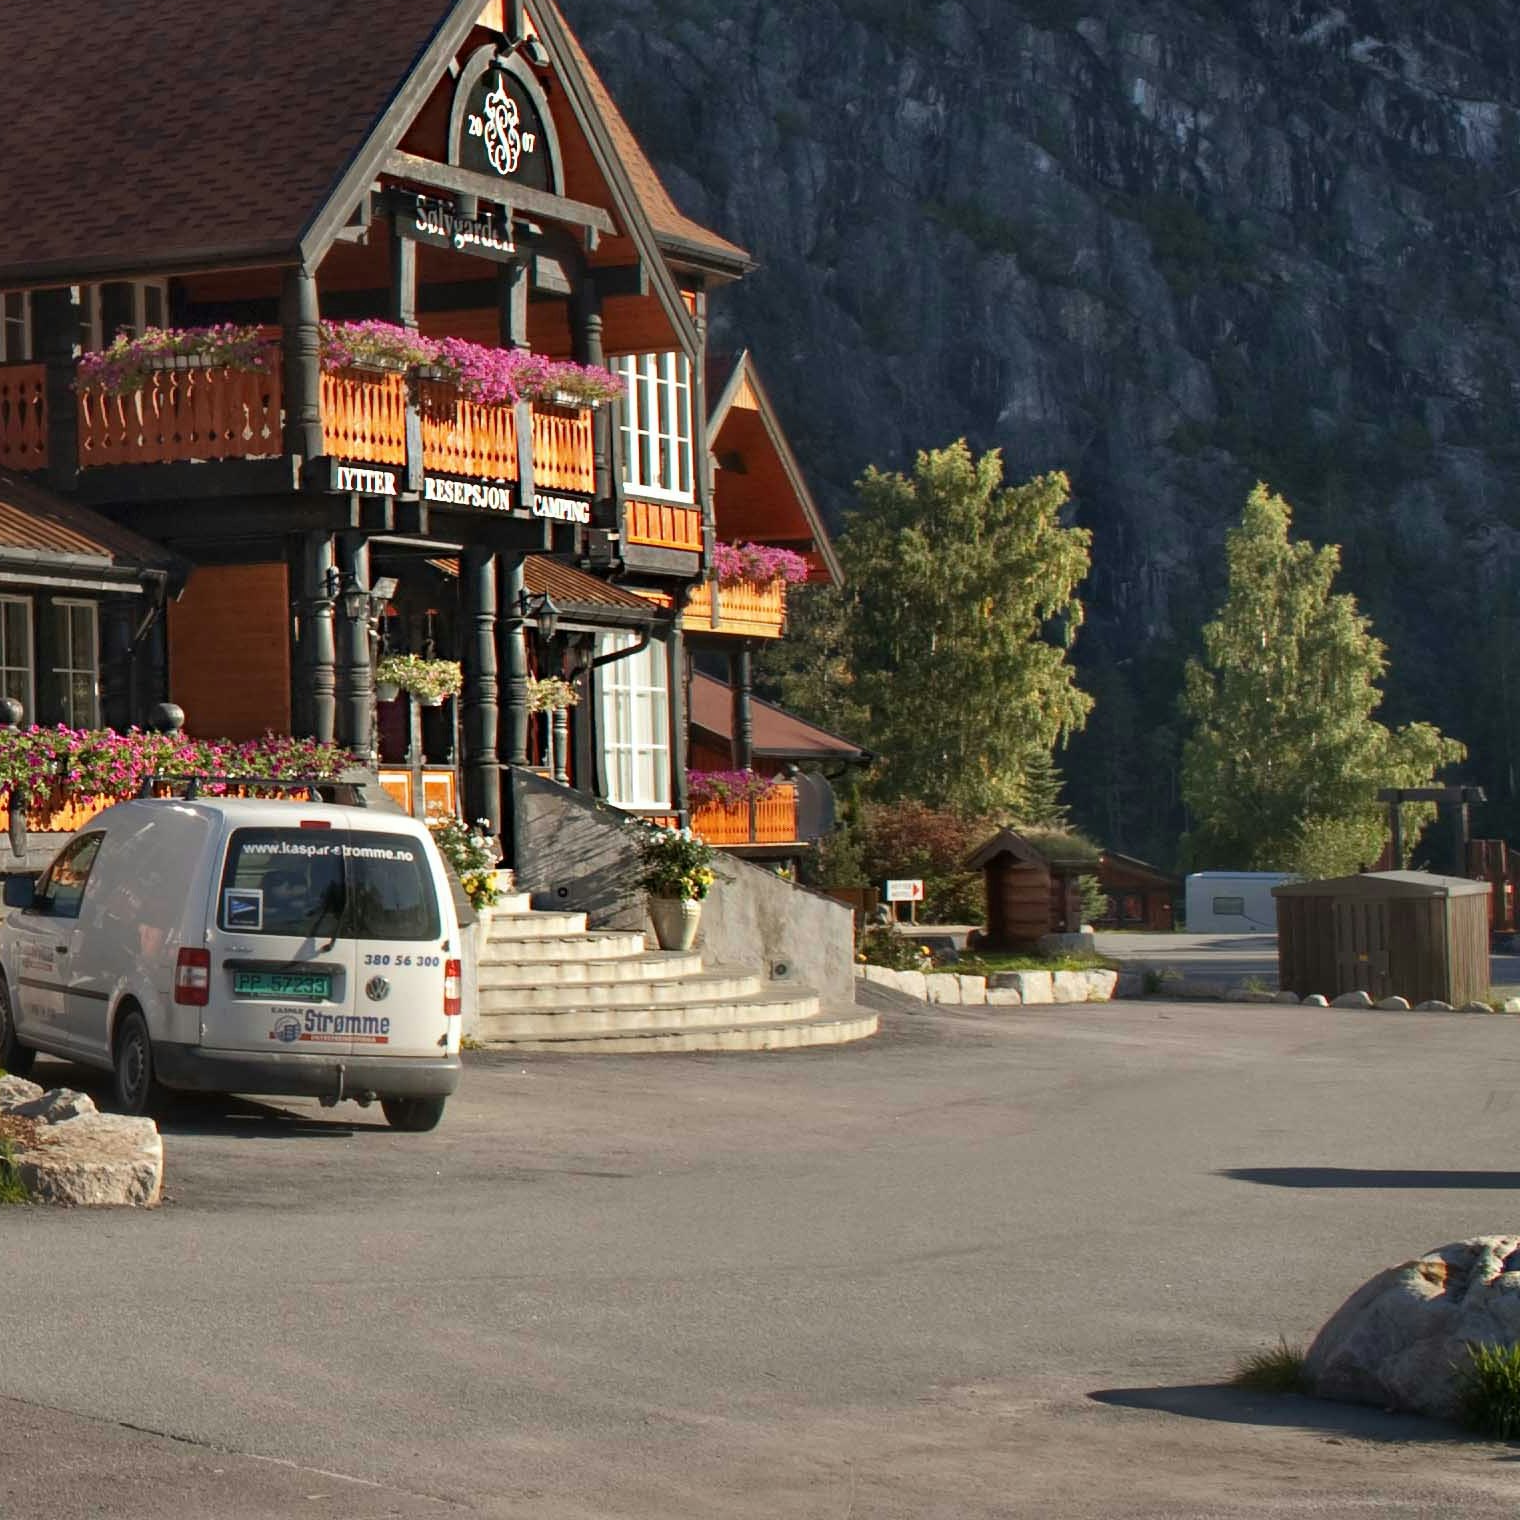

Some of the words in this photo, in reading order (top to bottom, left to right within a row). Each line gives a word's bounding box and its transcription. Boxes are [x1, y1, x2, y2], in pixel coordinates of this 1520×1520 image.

[468, 114, 483, 137] 20
[522, 132, 536, 153] 07
[424, 477, 510, 511] RESEPSJON
[533, 494, 590, 524] CAMPING
[364, 954, 390, 966] 380
[394, 955, 412, 967] 56
[416, 956, 440, 967] 300
[305, 1008, 390, 1034] Strømme
